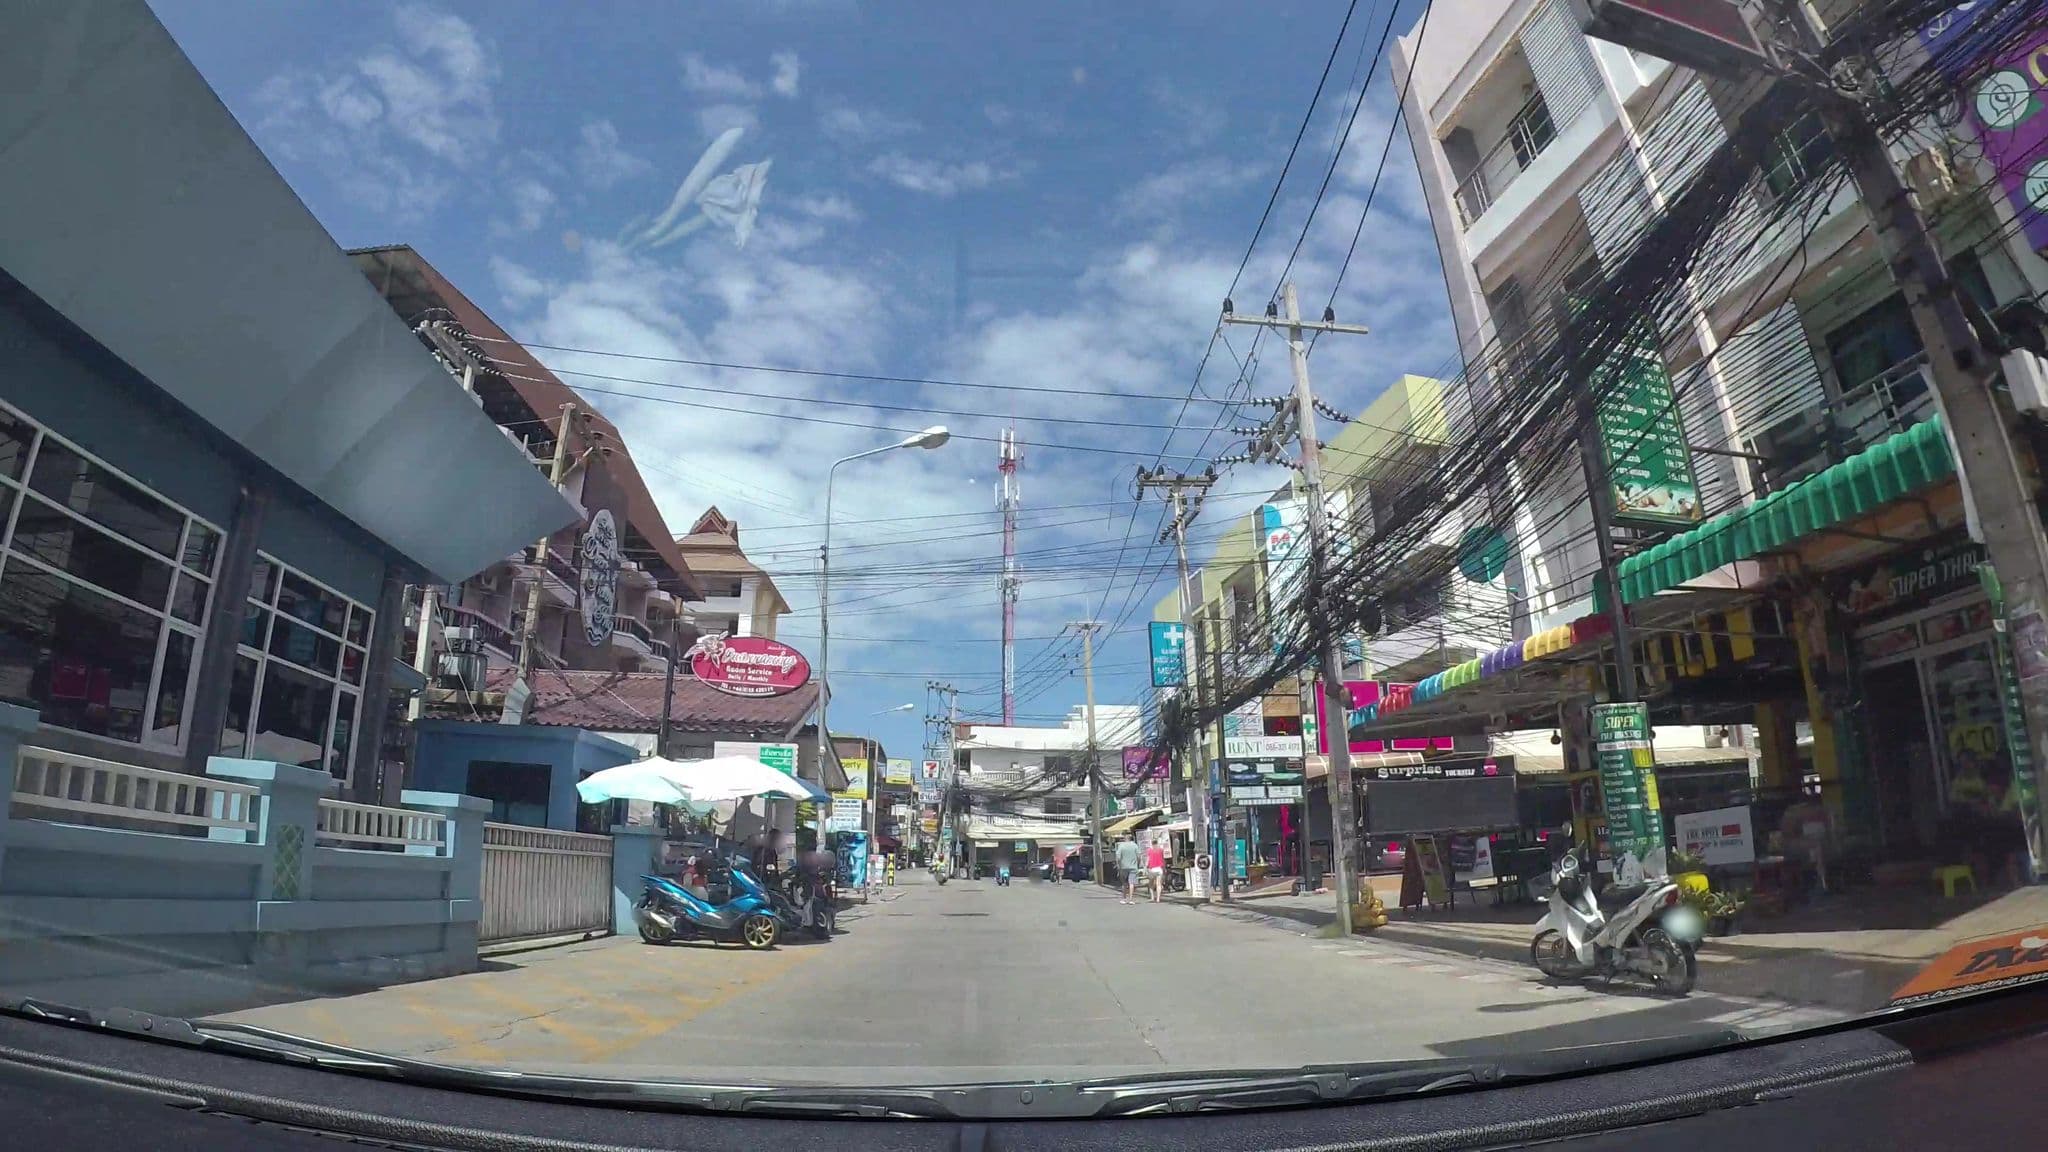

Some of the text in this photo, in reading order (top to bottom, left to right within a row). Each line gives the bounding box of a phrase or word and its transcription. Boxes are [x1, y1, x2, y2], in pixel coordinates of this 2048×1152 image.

[1888, 565, 1937, 600] SUPER
[726, 665, 773, 676] Room Service
[1604, 715, 1634, 729] SUPER
[1227, 741, 1262, 754] RENT
[1377, 764, 1442, 779] Surprise
[887, 853, 895, 885] TAXI
